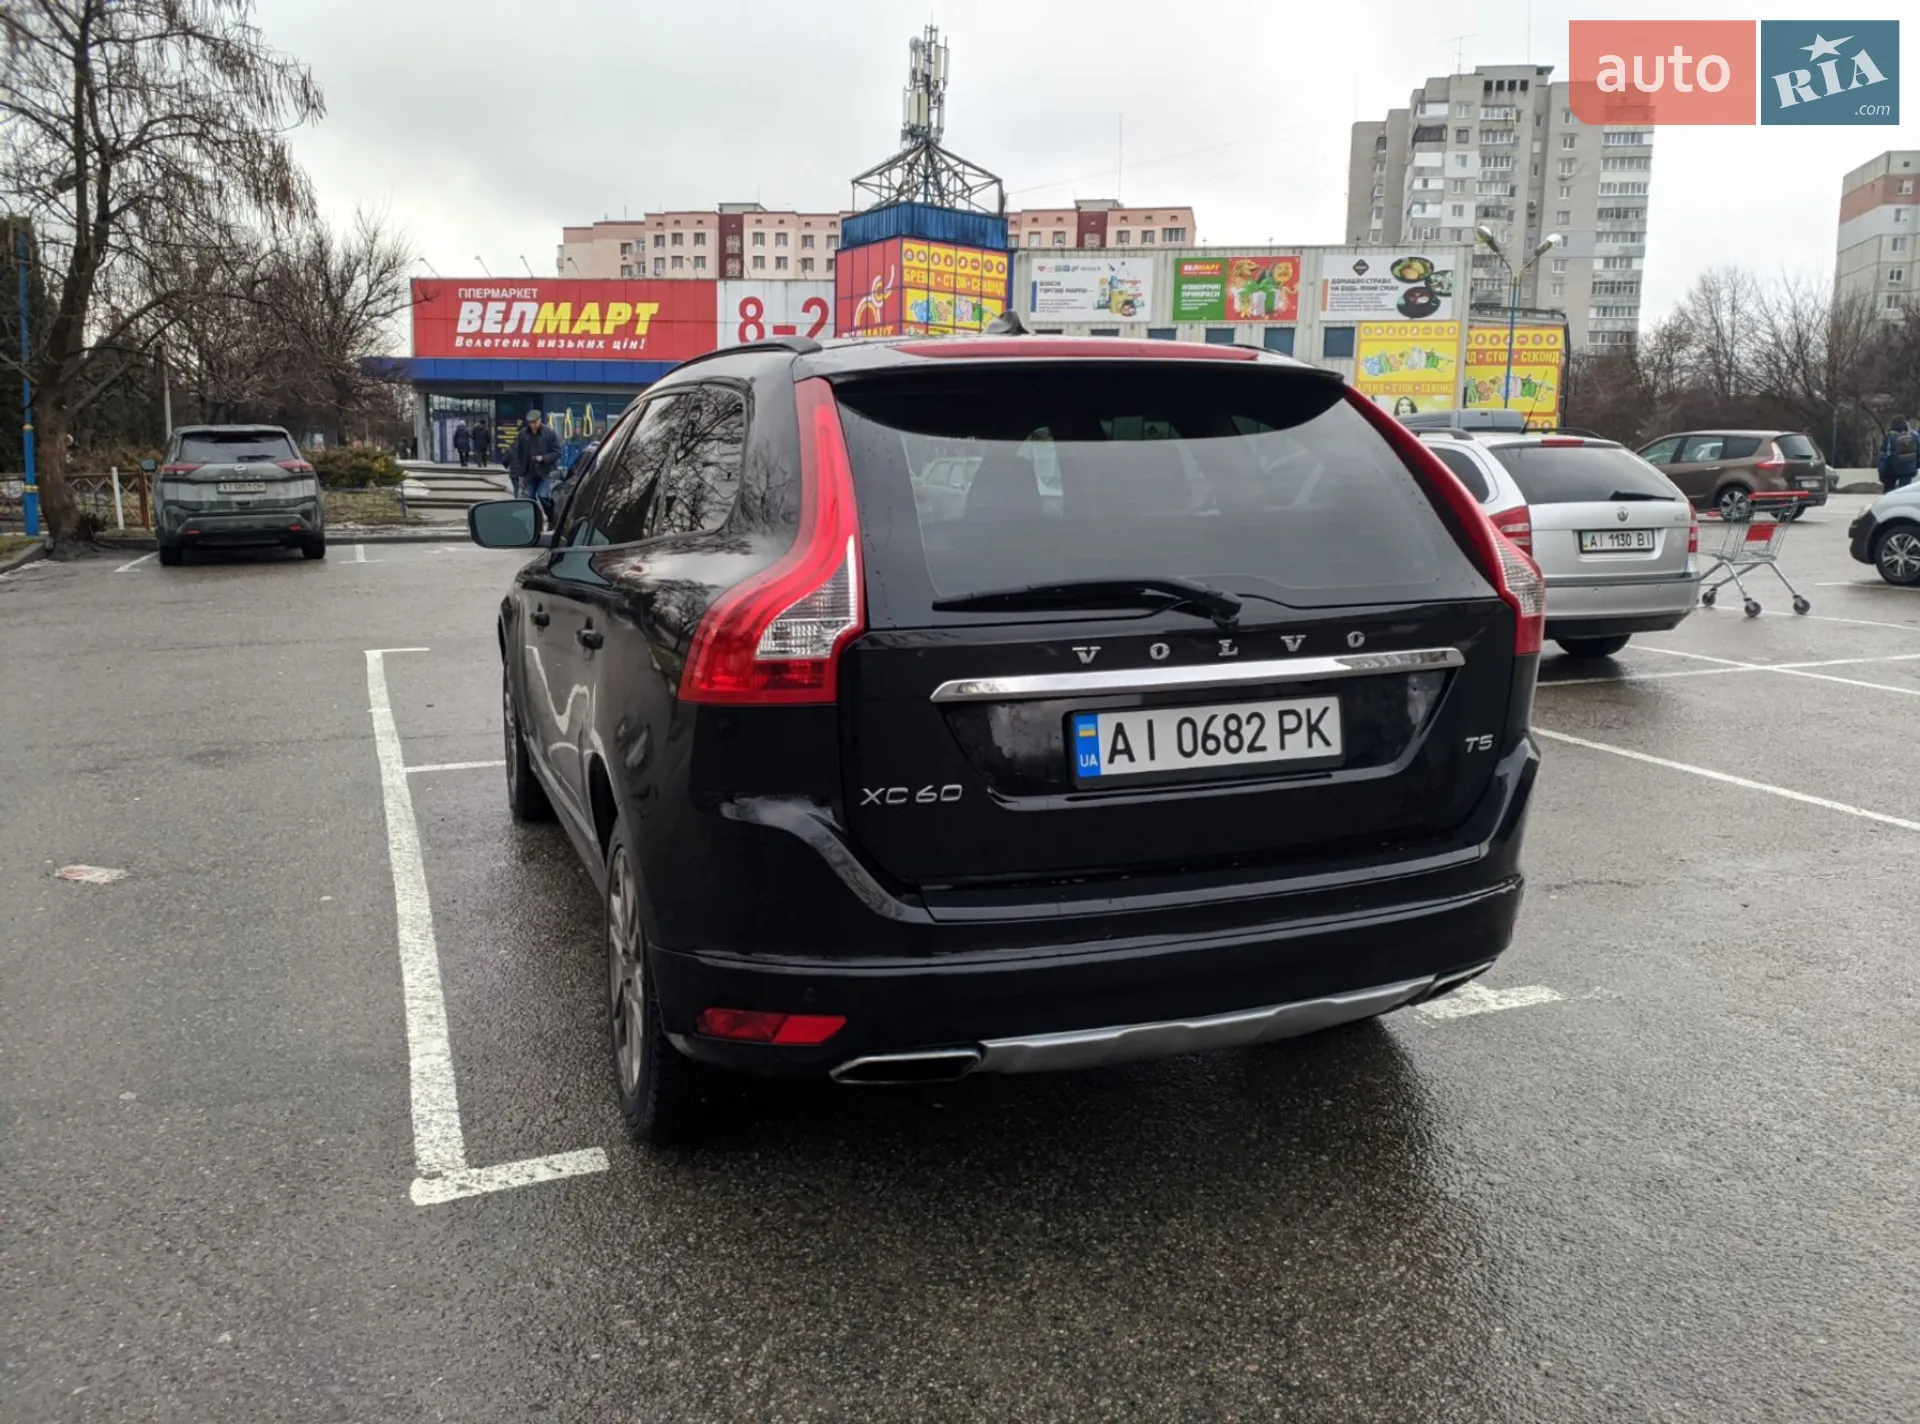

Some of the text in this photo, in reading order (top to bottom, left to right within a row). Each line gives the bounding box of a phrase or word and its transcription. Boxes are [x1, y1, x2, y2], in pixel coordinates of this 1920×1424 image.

[458, 288, 538, 299] ГІПЕРМАРКЕТ
[456, 301, 660, 336] ВЕЛМАРТ
[455, 336, 530, 348] Велетень
[537, 337, 605, 349] низьких
[1486, 351, 1509, 363] СТО
[1590, 533, 1603, 548] AI
[1608, 532, 1632, 547] 1130
[1073, 630, 1366, 664] VOLVO
[1107, 704, 1333, 765] AI 0682 PK
[1465, 735, 1493, 753] T5
[1079, 753, 1099, 769] UA
